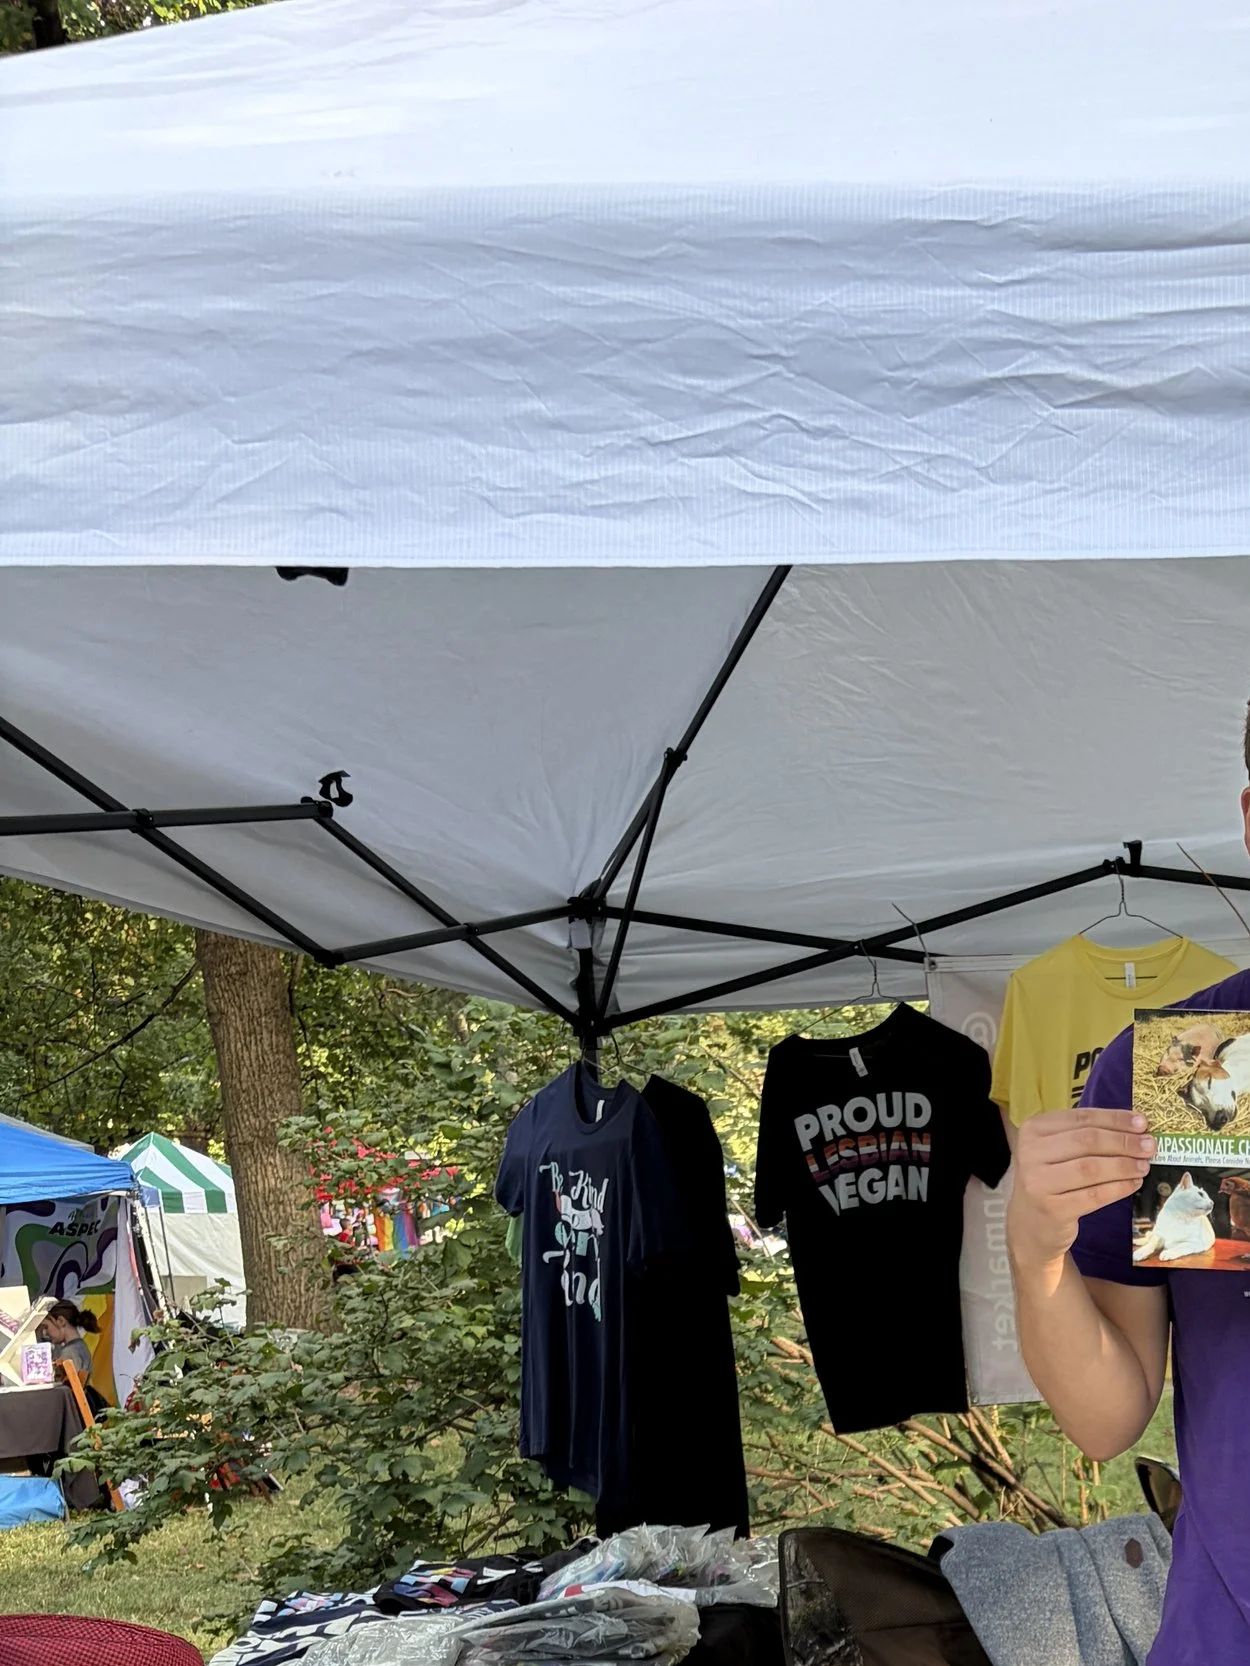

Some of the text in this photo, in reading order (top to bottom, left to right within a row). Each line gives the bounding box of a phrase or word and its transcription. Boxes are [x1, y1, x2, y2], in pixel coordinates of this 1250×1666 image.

[793, 1091, 932, 1152] PROUD
[805, 1131, 931, 1182] LESBIAN
[818, 1165, 930, 1216] VEGAN
